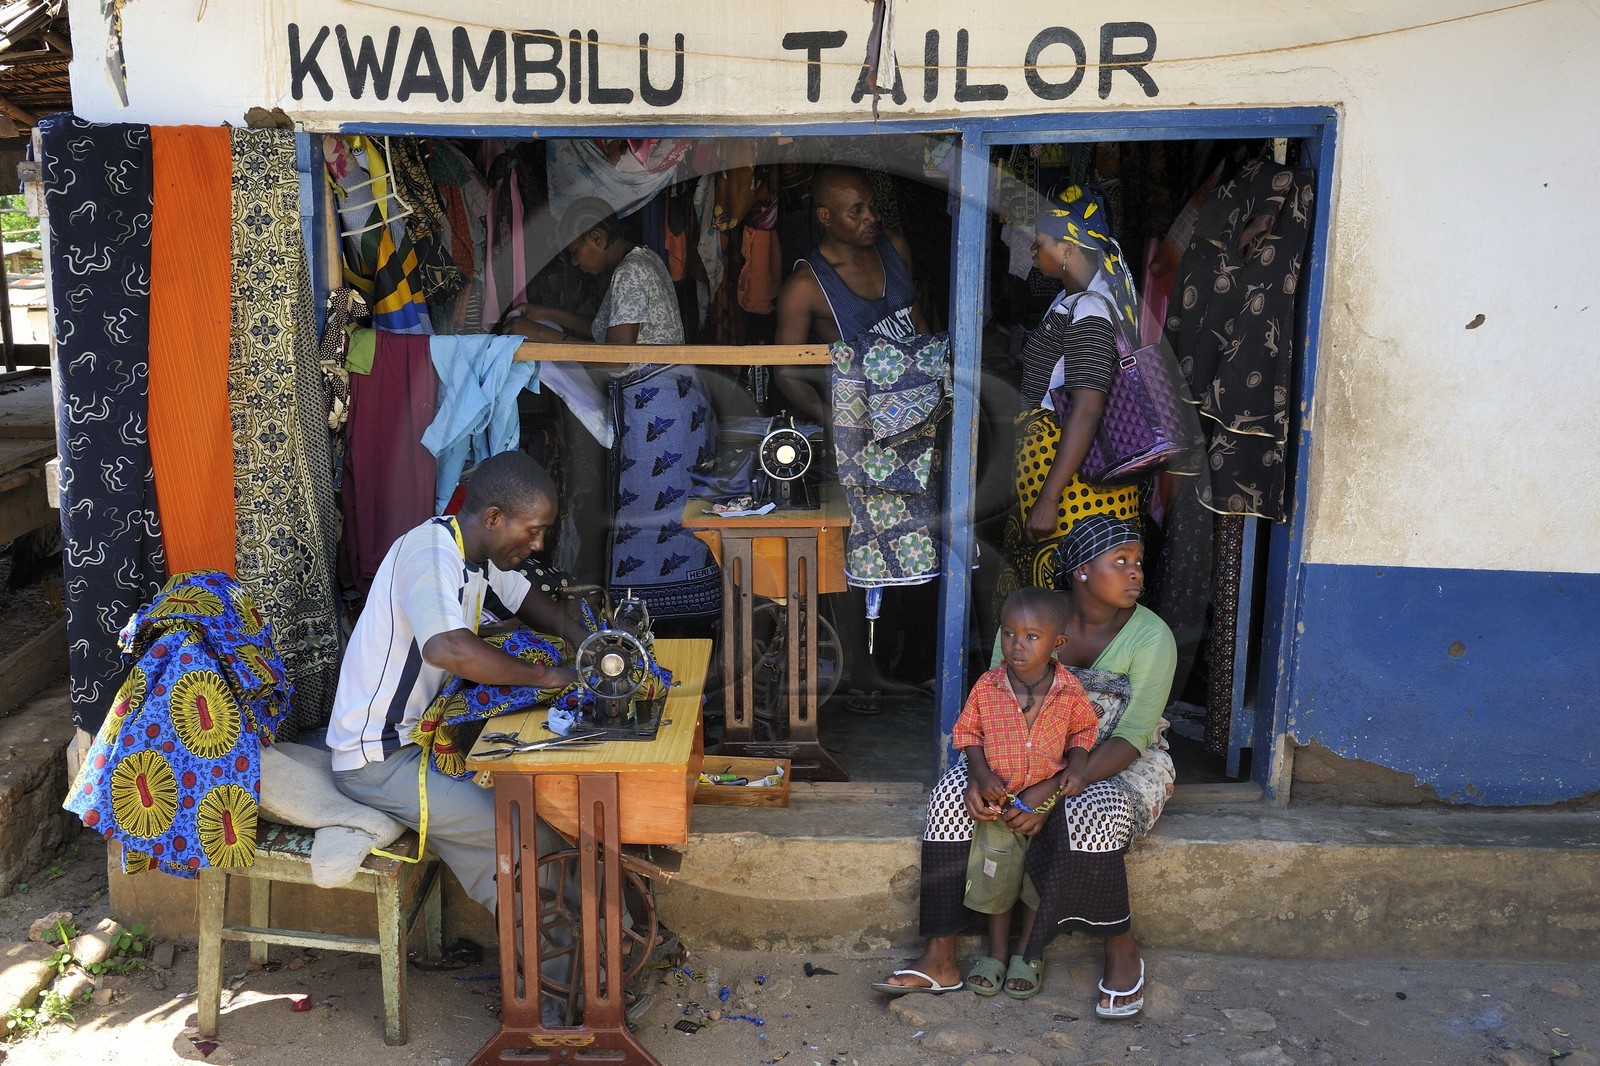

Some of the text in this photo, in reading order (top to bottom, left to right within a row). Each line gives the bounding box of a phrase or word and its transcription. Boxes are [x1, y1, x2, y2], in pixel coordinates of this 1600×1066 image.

[287, 21, 1160, 106] KWAMBILU TAILOR
[690, 568, 709, 579] HERI
